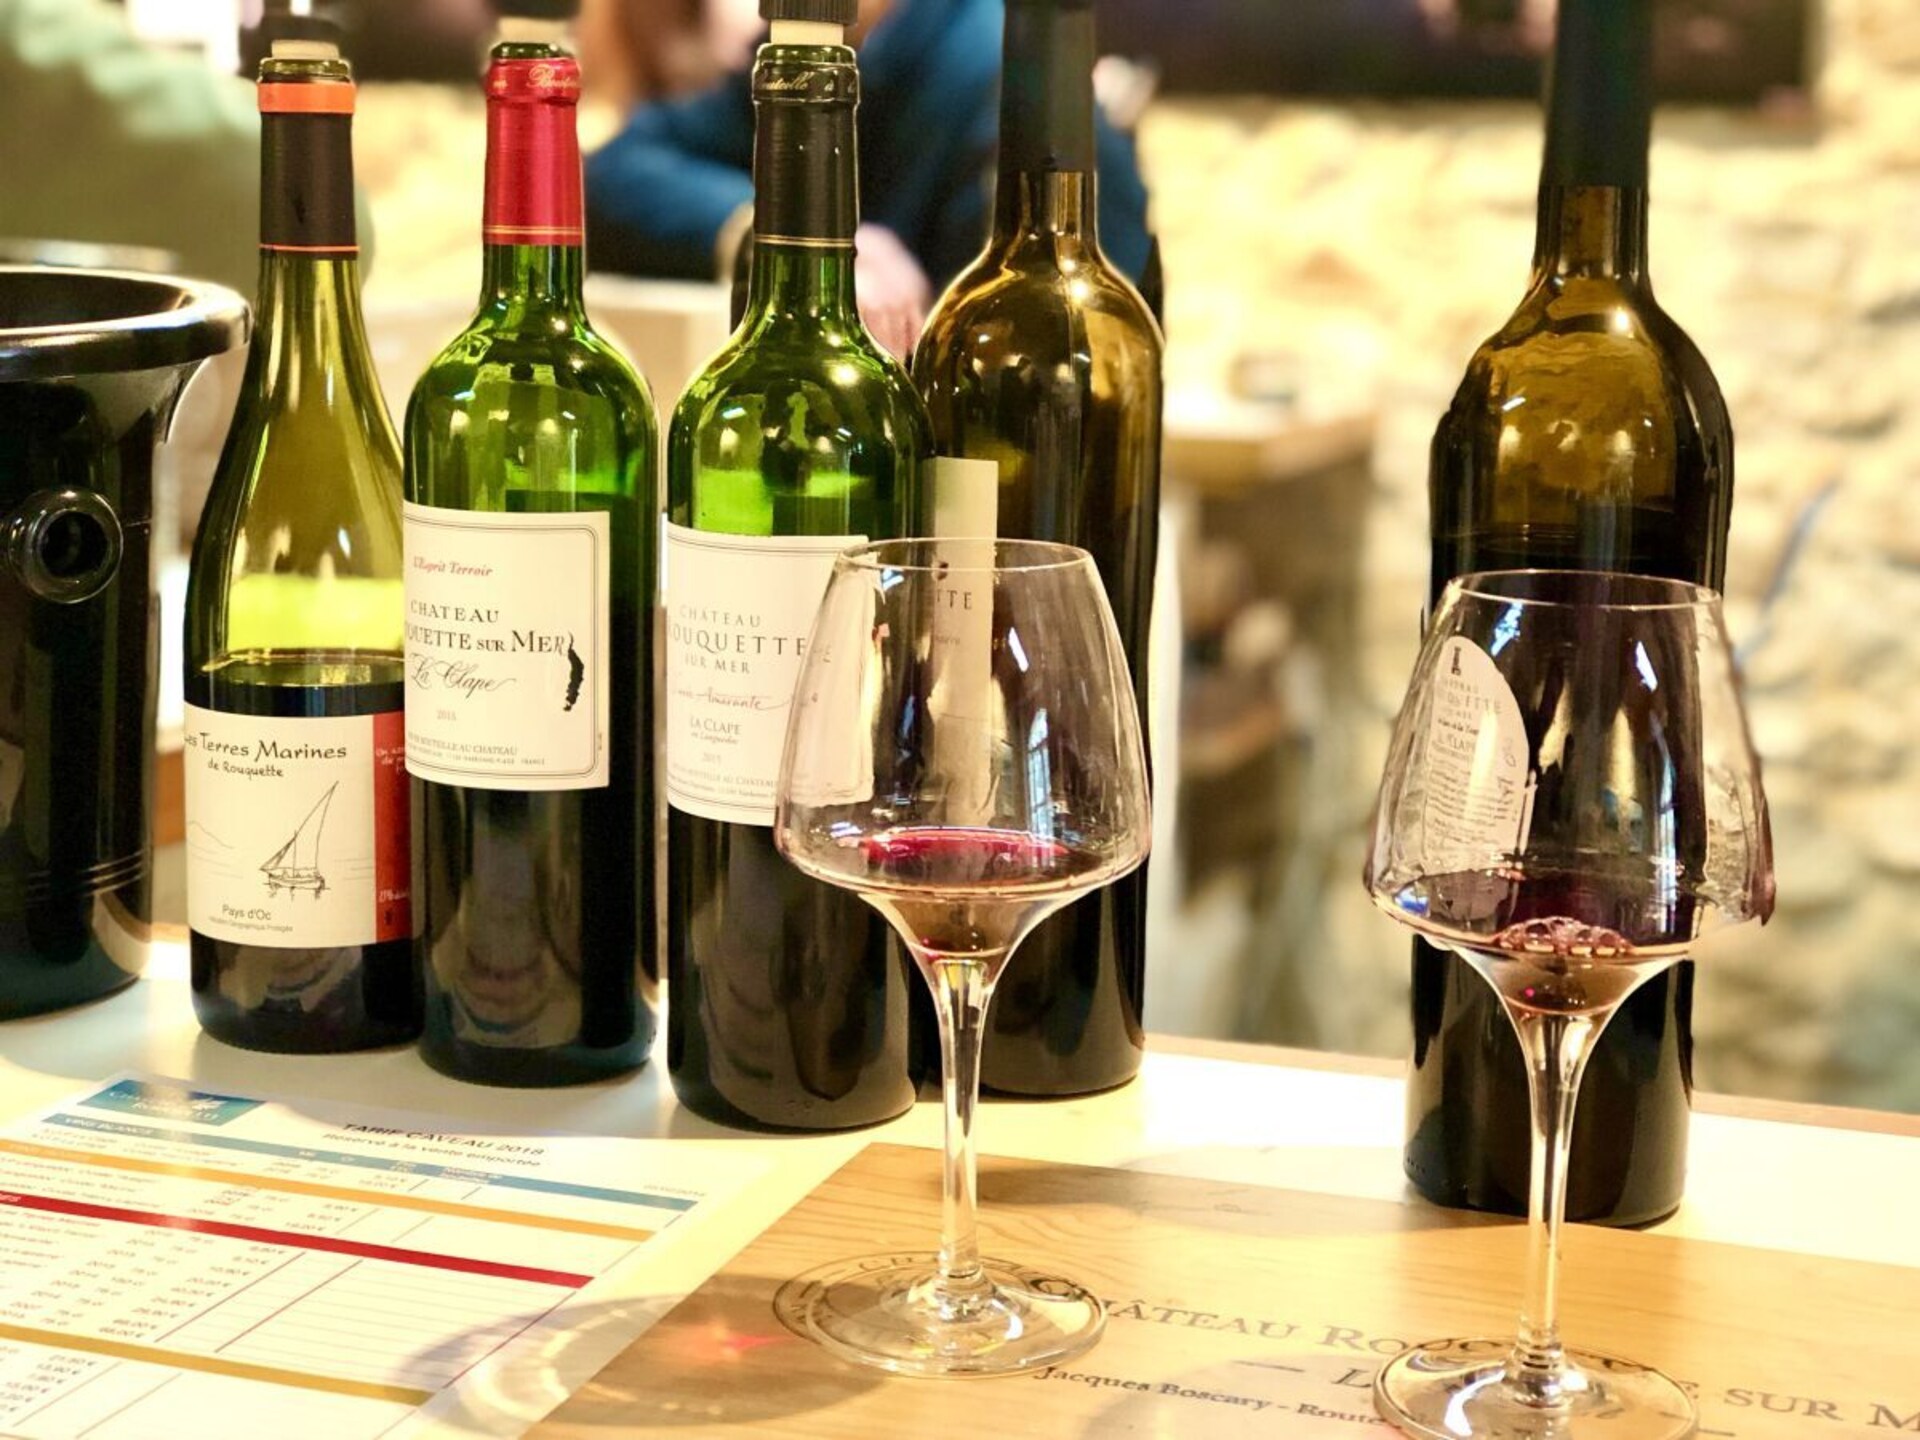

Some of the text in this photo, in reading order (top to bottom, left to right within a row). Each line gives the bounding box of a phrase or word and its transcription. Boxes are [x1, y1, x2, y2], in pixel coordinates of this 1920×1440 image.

[410, 599, 499, 623] CHATEAU
[669, 622, 806, 656] OUQUETTE
[715, 659, 750, 675] MER
[200, 732, 249, 756] Terres
[254, 740, 347, 763] Marines
[208, 758, 285, 780] de Rouquette
[222, 903, 272, 921] Pays d'Oc
[495, 1142, 545, 1156] 2018
[1034, 1366, 1150, 1394] Jacques
[1157, 1382, 1269, 1412] Boscary
[1296, 1402, 1384, 1427] Route
[1724, 1387, 1844, 1422] SUR
